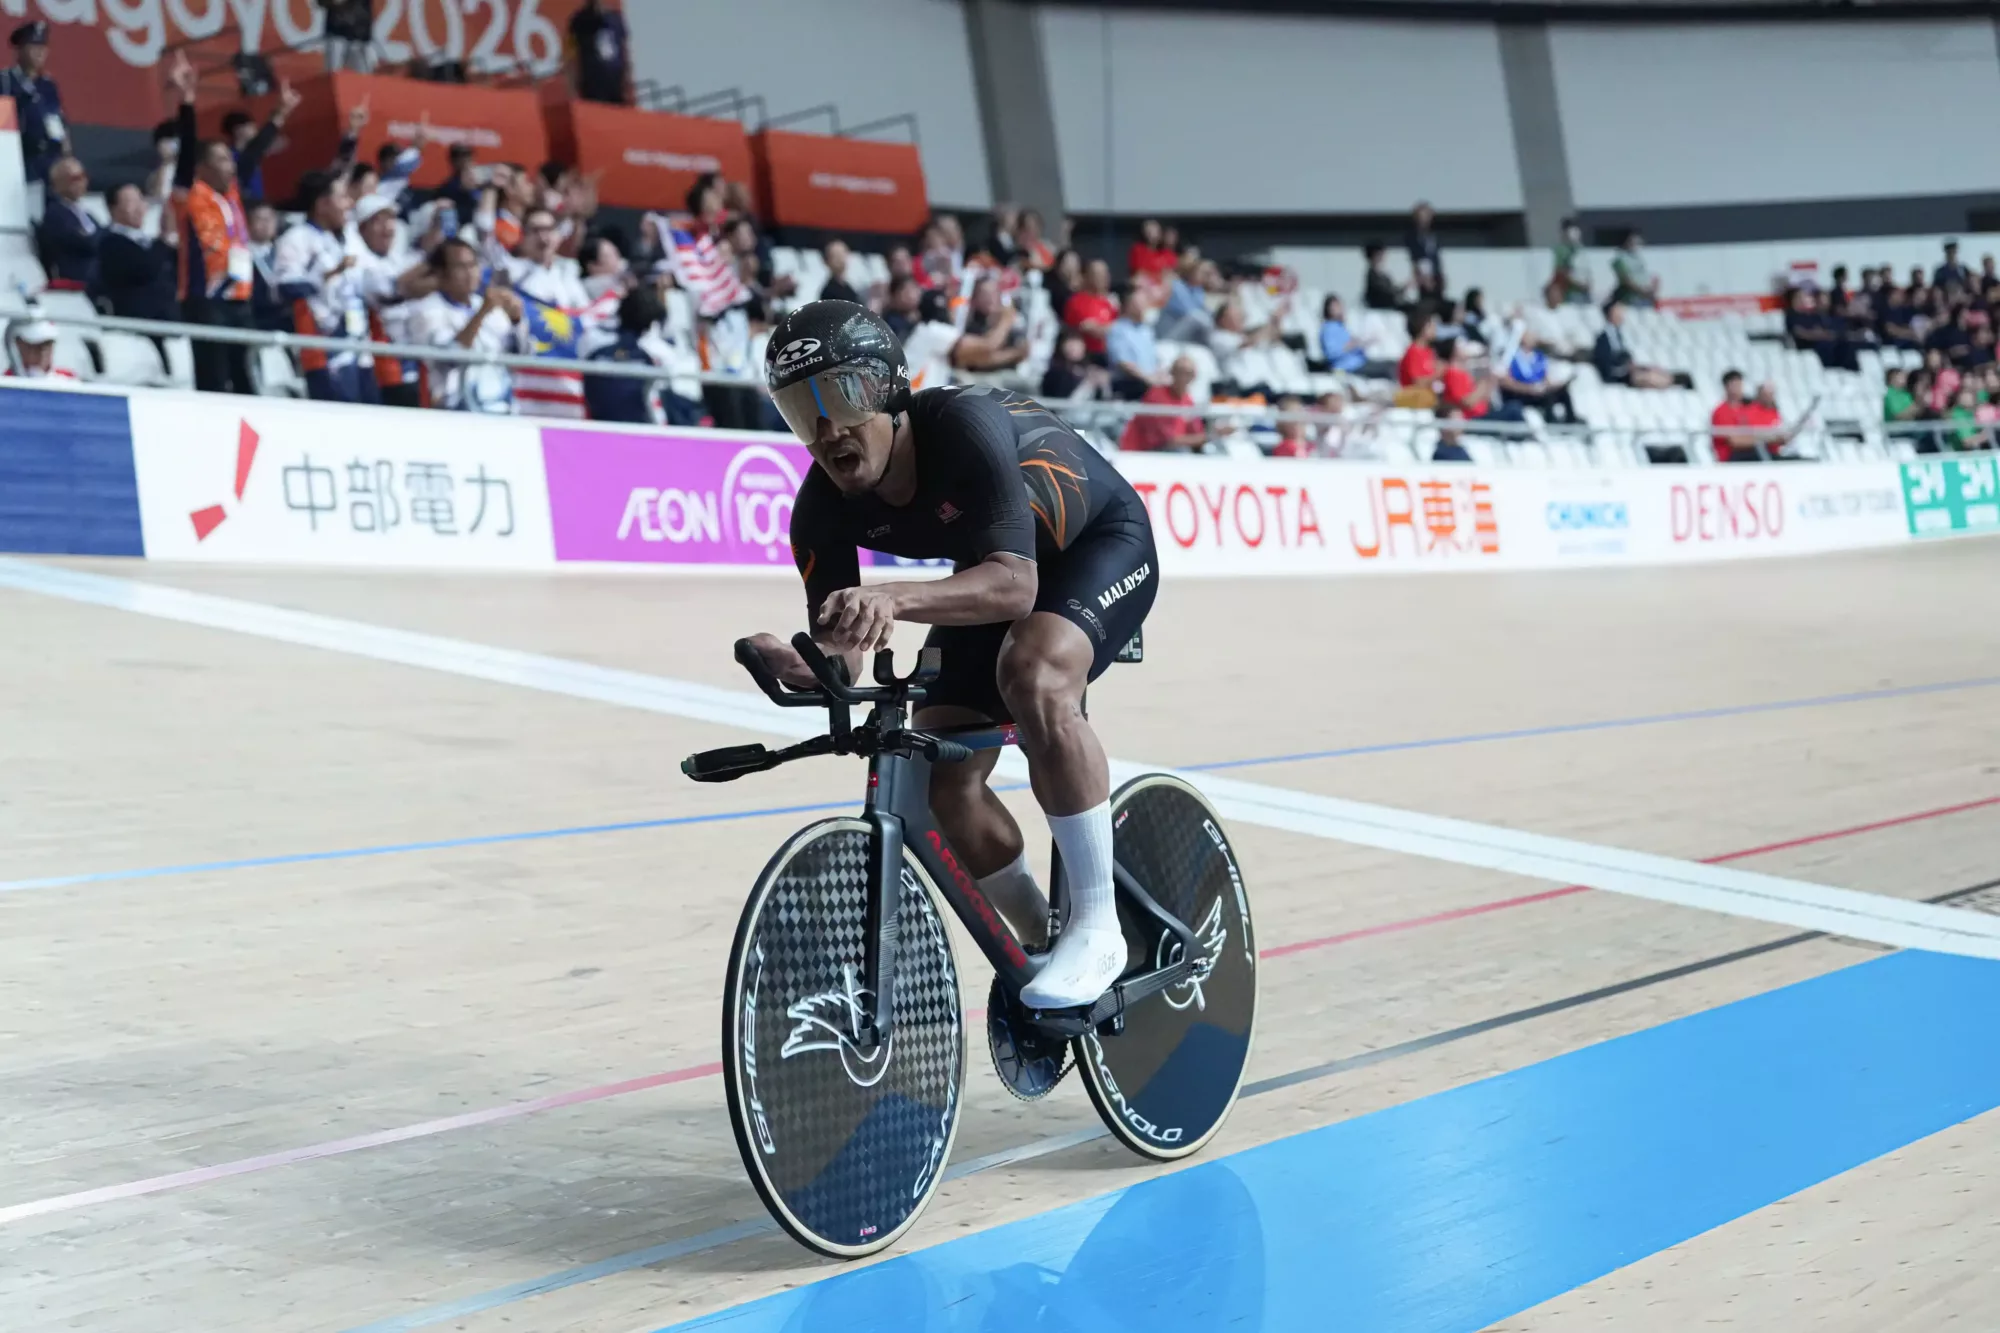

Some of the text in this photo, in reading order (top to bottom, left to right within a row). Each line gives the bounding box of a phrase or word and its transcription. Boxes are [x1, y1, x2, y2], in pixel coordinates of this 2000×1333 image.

[779, 355, 823, 378] Kabuto
[282, 452, 516, 536] 中部電力
[1132, 482, 1327, 549] TOYOTA
[1670, 481, 1785, 542] DENSO
[1097, 562, 1150, 610] MALAYSIA
